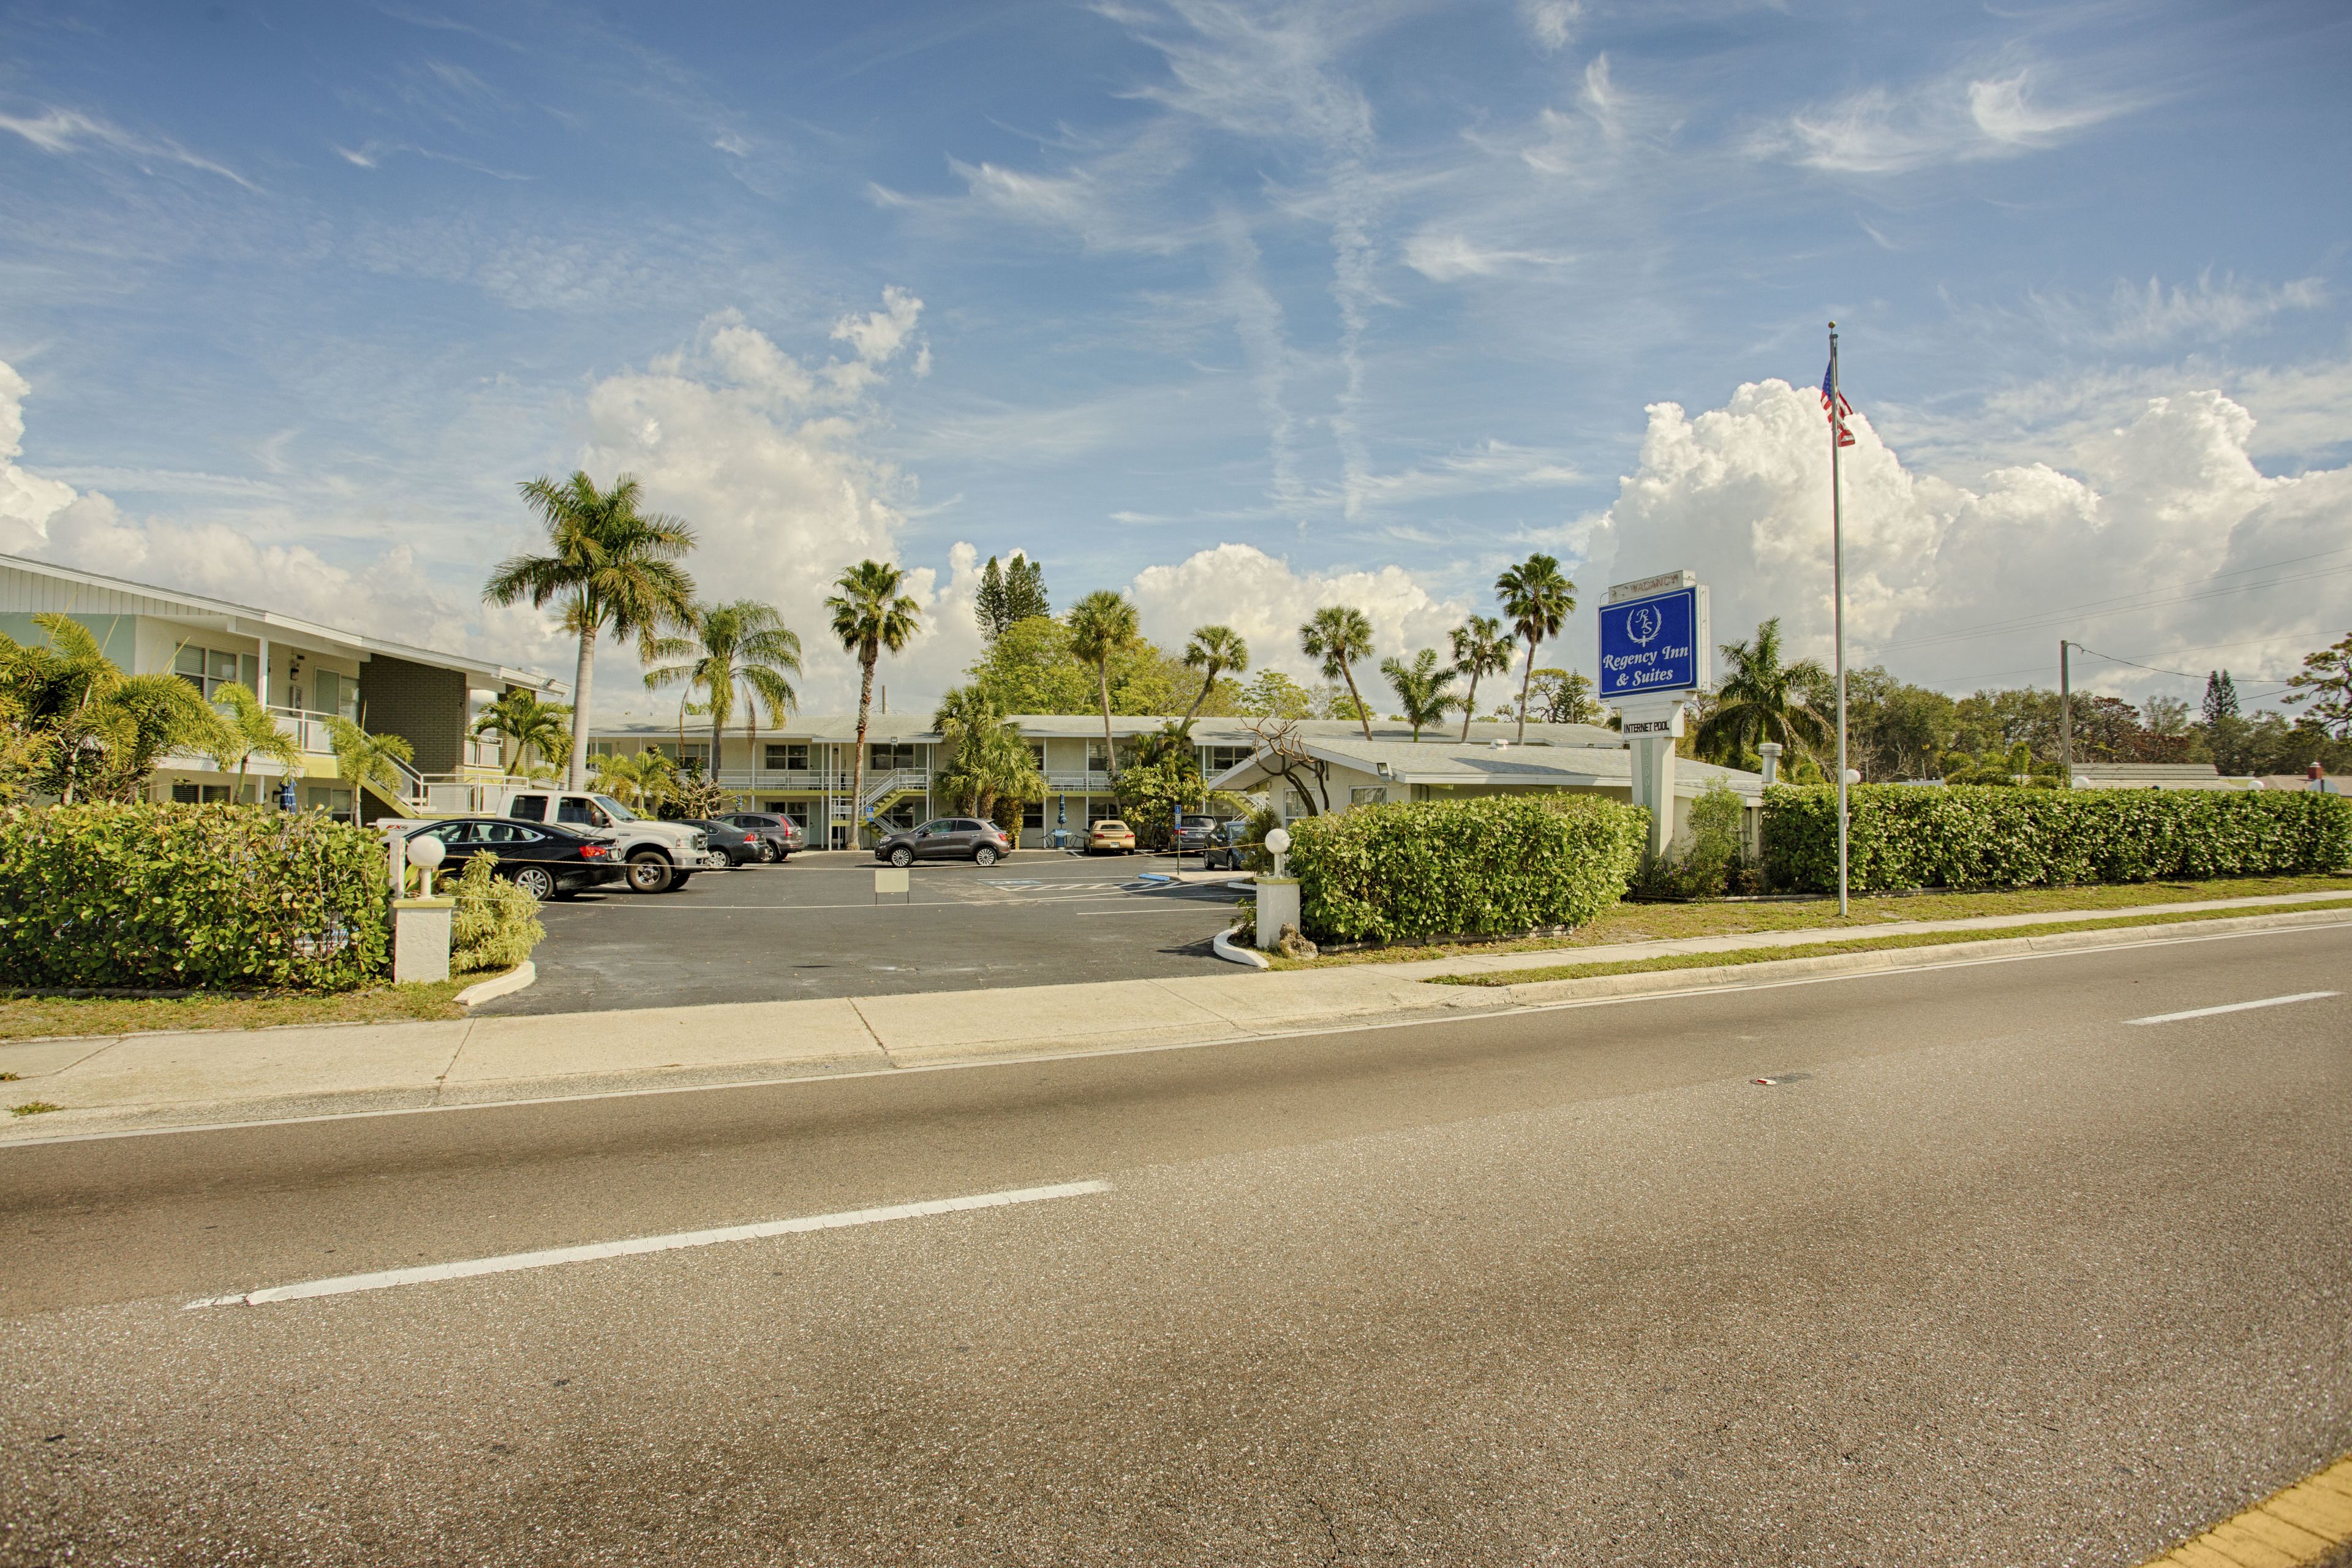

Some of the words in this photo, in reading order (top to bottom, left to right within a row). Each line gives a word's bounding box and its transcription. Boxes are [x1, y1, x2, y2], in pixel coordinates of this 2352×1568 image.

[1602, 651, 1658, 671] Regency
[1662, 646, 1689, 660] Inn
[1616, 673, 1629, 687] &
[1632, 668, 1673, 687] Suites
[1624, 723, 1653, 733] INTERNET
[1654, 721, 1669, 731] POOL
